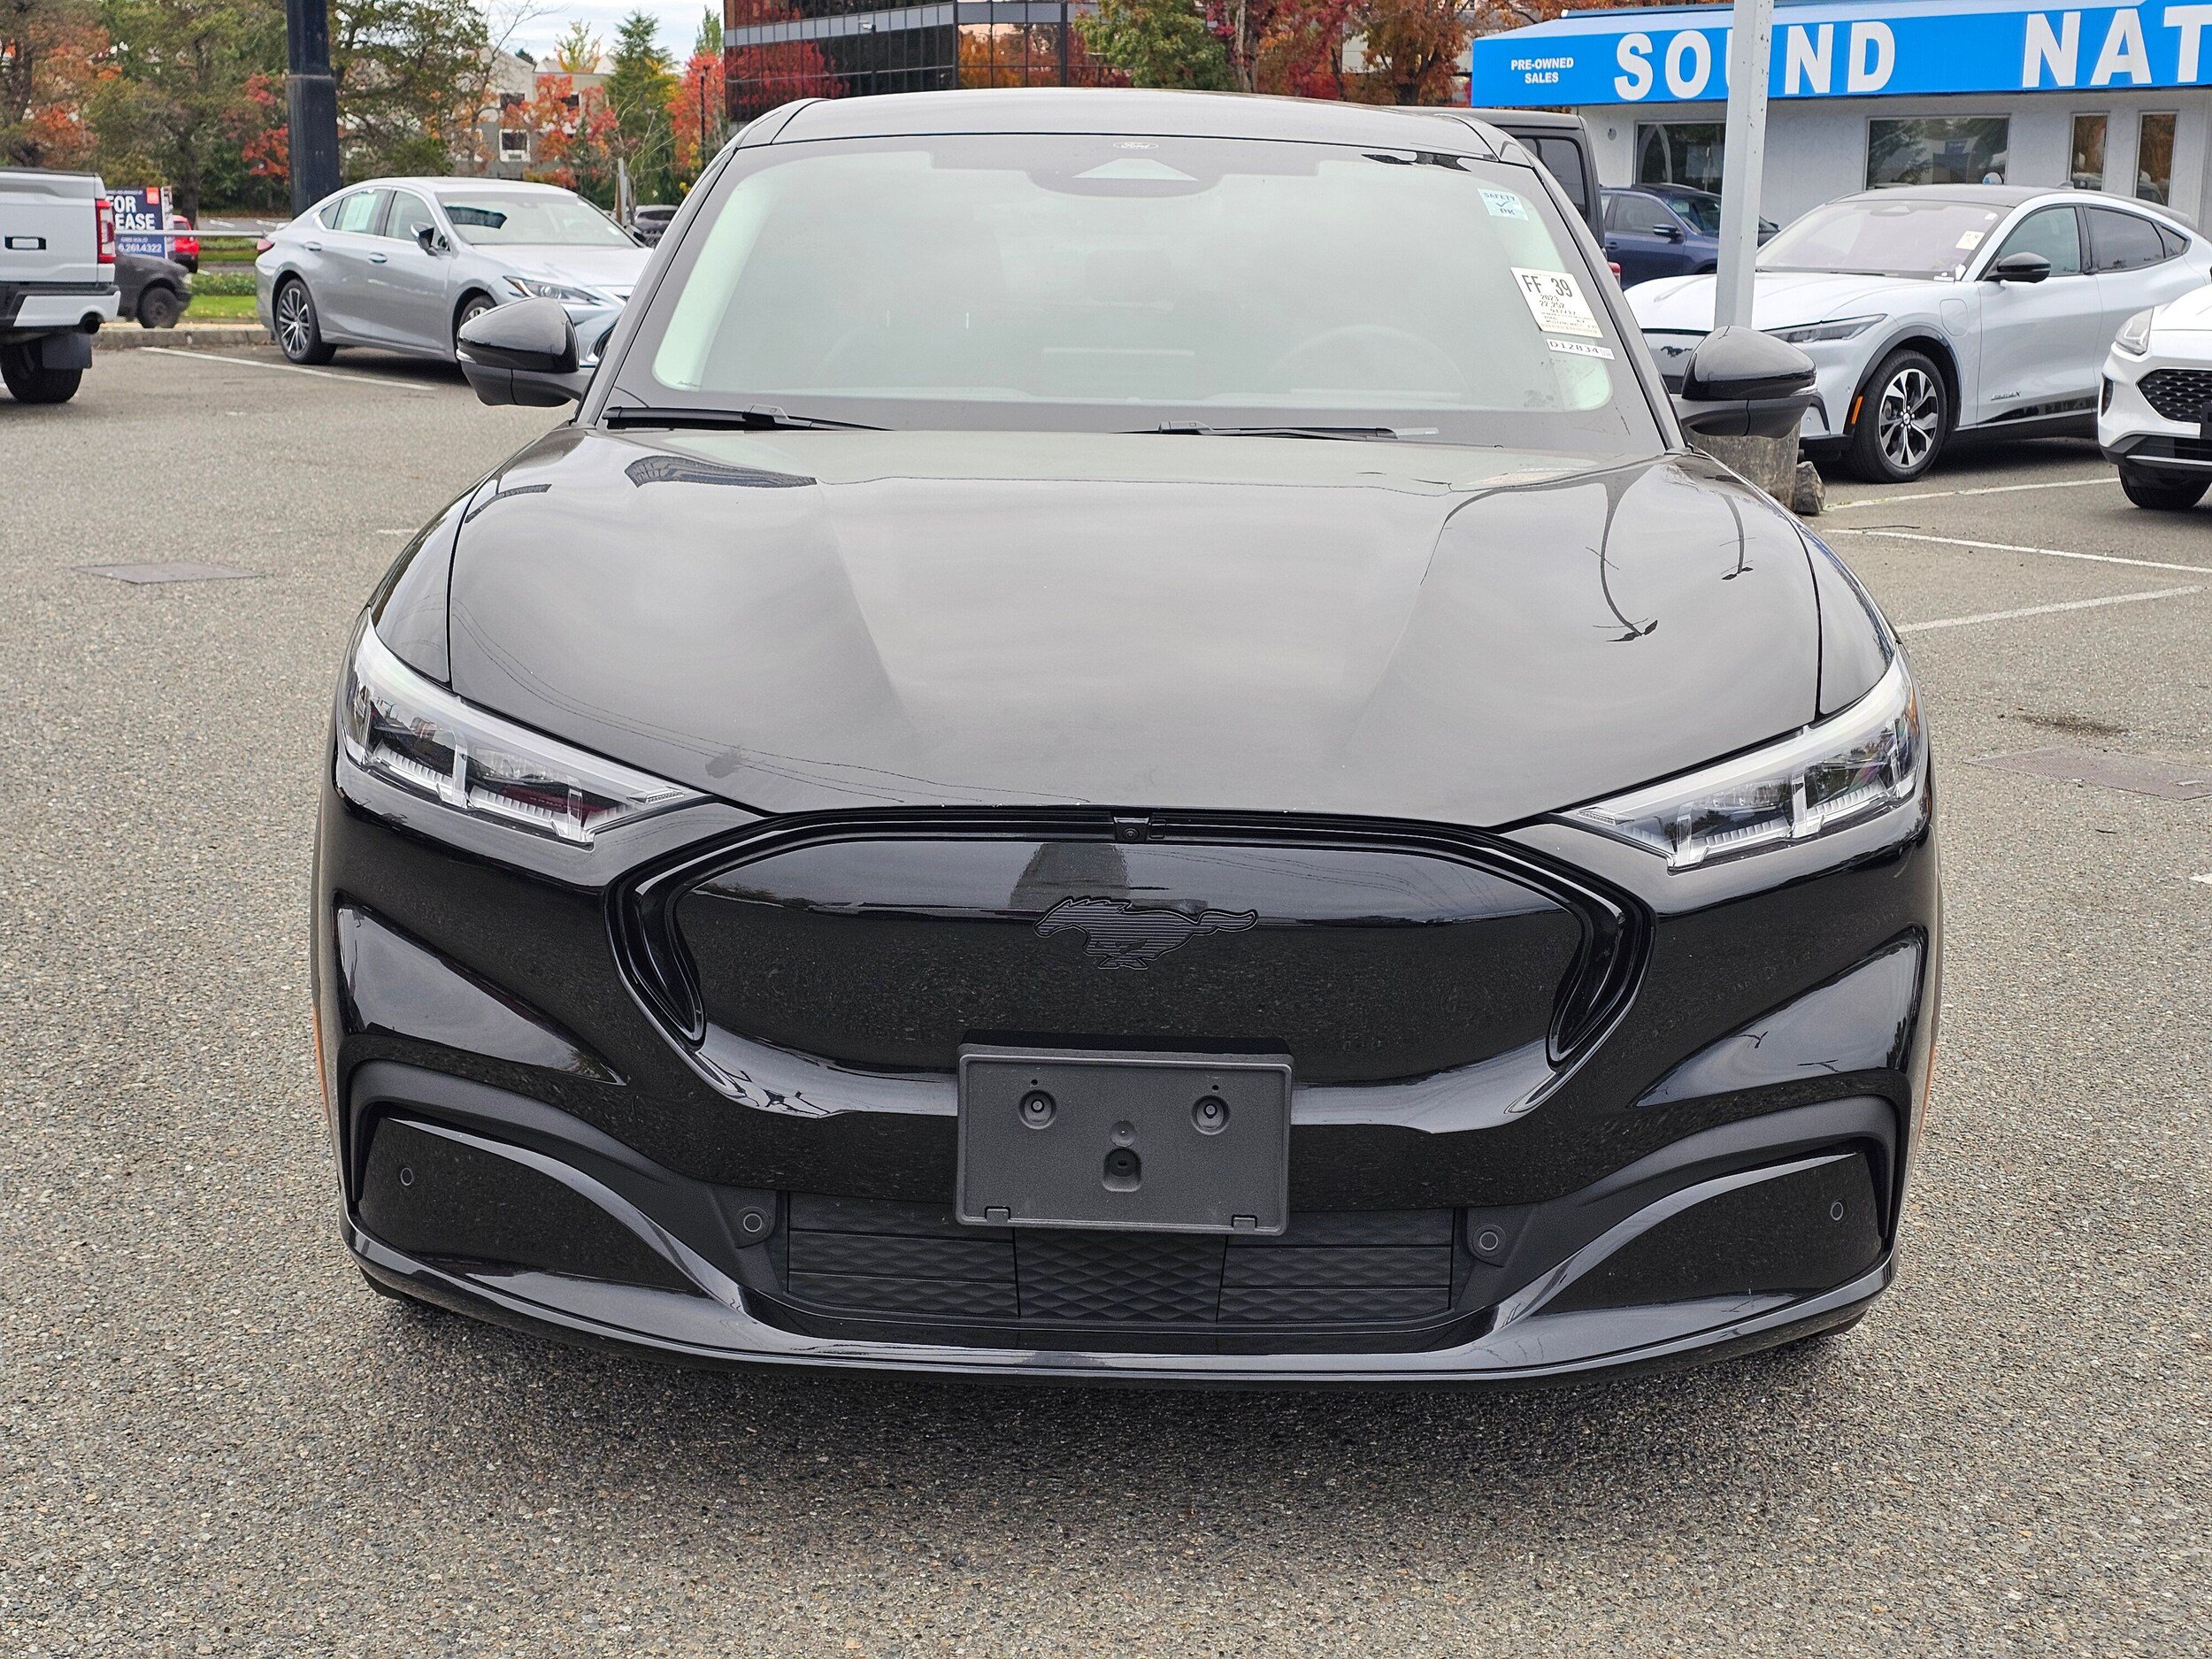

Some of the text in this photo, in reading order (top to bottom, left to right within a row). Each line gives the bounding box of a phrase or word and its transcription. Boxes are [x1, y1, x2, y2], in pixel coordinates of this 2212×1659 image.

[1510, 57, 1574, 71] PRE-OWNED
[1614, 21, 1895, 101] SOND
[1525, 71, 1559, 84] SALES
[115, 213, 156, 230] EASE
[1522, 274, 1573, 297] FF 39
